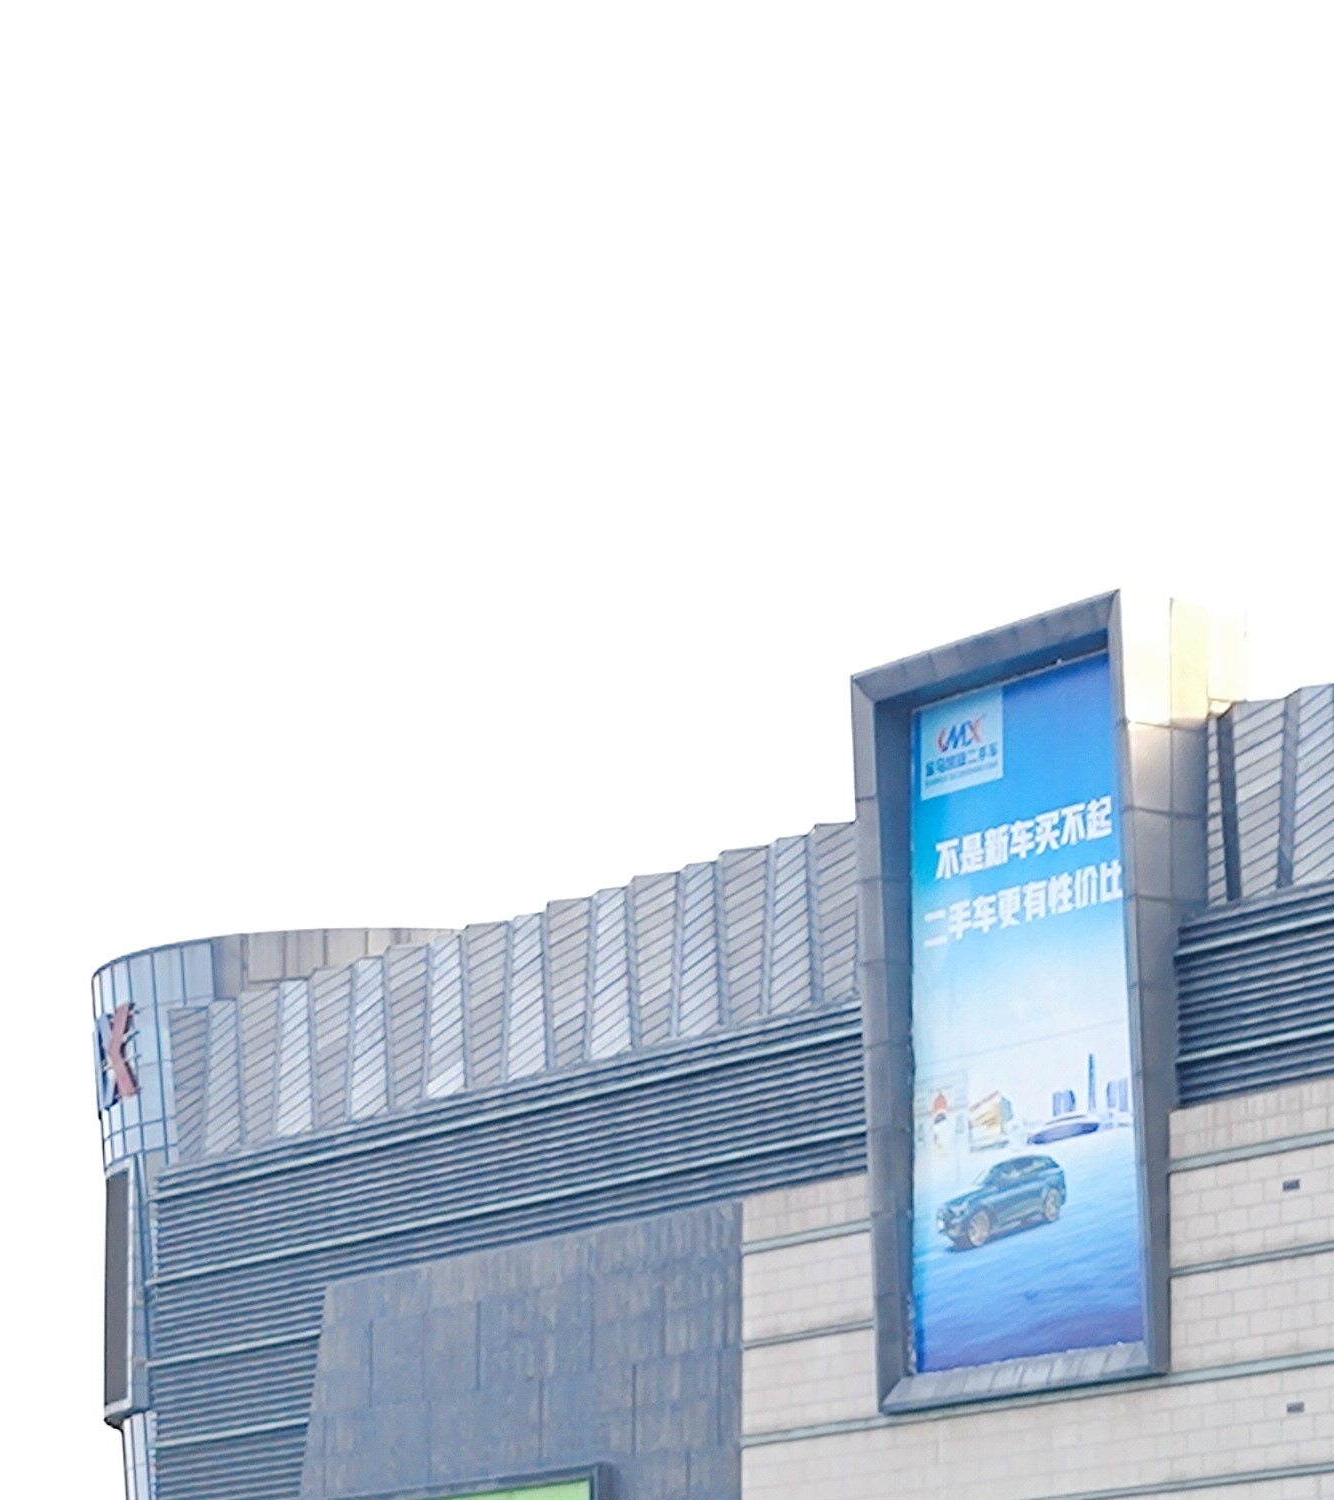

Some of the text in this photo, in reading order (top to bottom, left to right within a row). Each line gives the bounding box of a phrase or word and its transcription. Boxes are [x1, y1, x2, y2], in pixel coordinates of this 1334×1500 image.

[934, 795, 1112, 880] 不是新车买不起
[923, 859, 1124, 948] 二手车更有性价比
